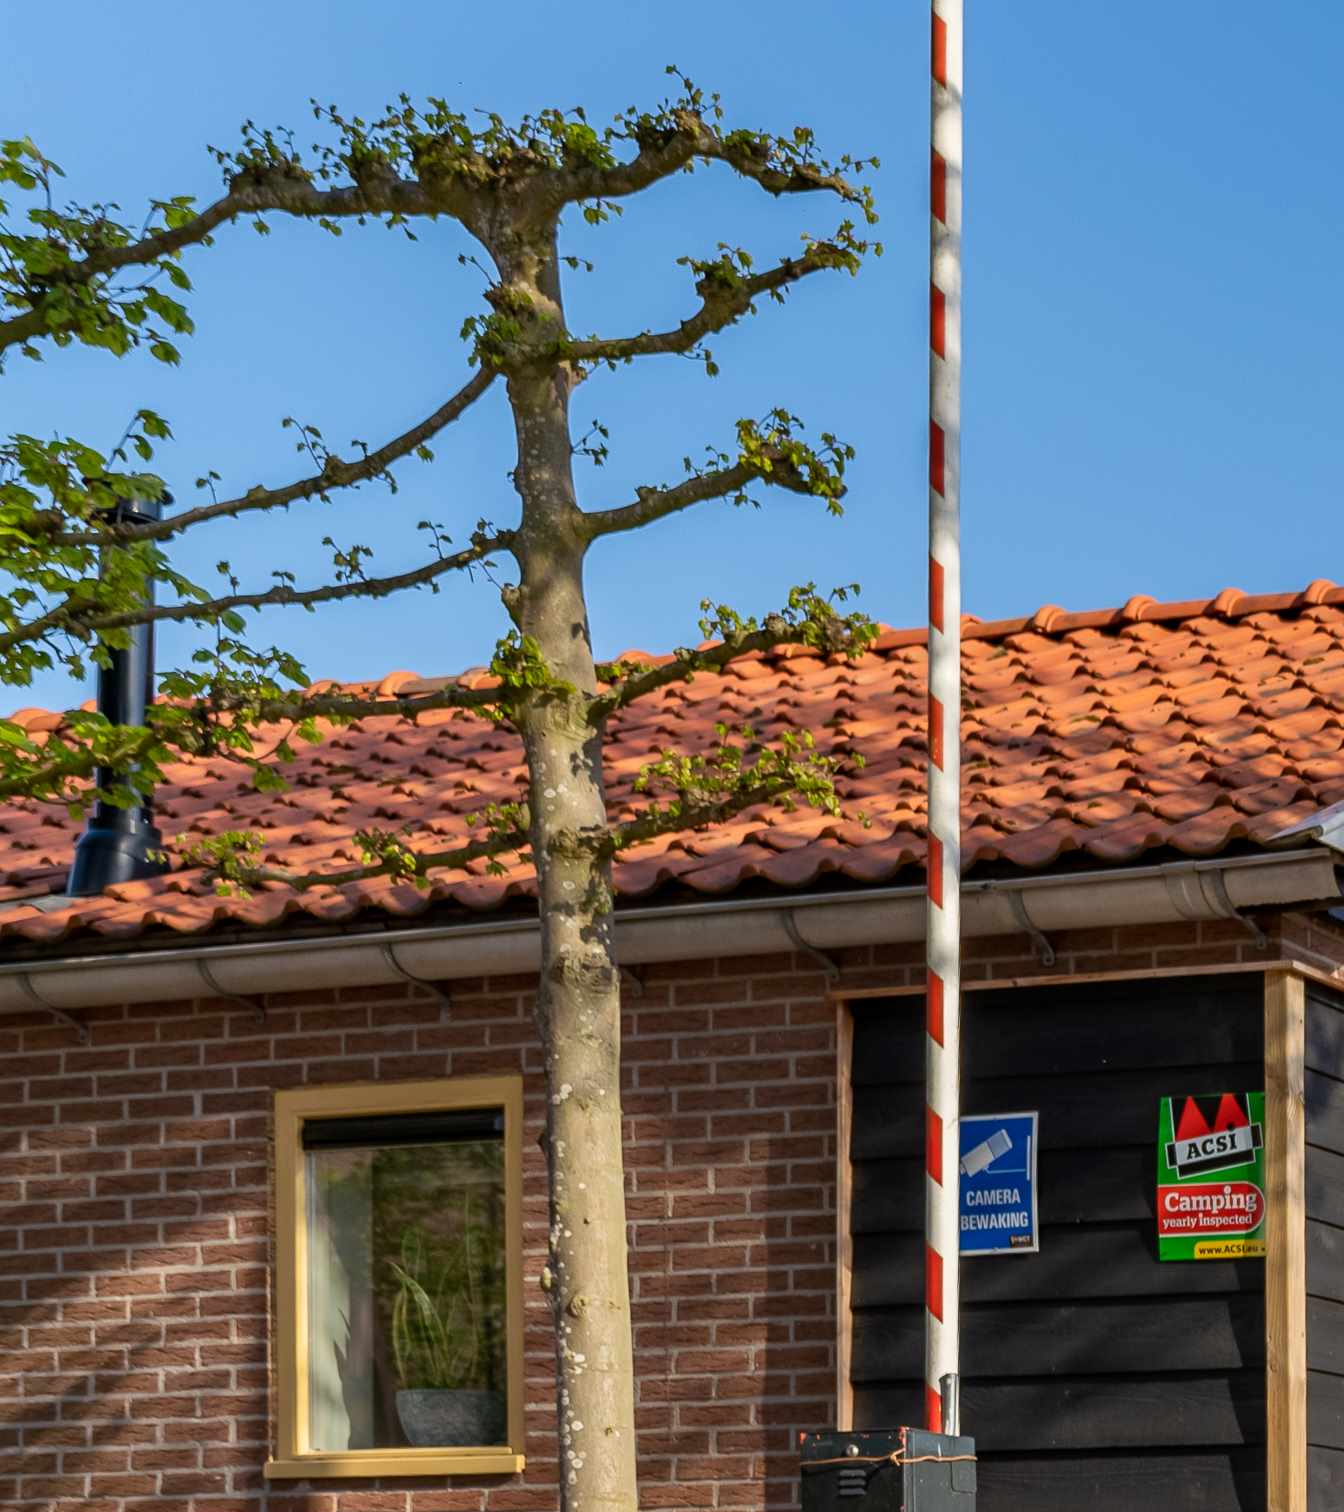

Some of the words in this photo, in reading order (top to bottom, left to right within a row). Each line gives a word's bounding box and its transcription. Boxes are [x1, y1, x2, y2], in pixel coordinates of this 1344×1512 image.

[966, 1188, 1021, 1206] CAMERA
[1164, 1184, 1257, 1213] Camping
[960, 1211, 1029, 1231] BEWAKING
[1163, 1216, 1197, 1229] yearly
[1199, 1212, 1252, 1228] inspected
